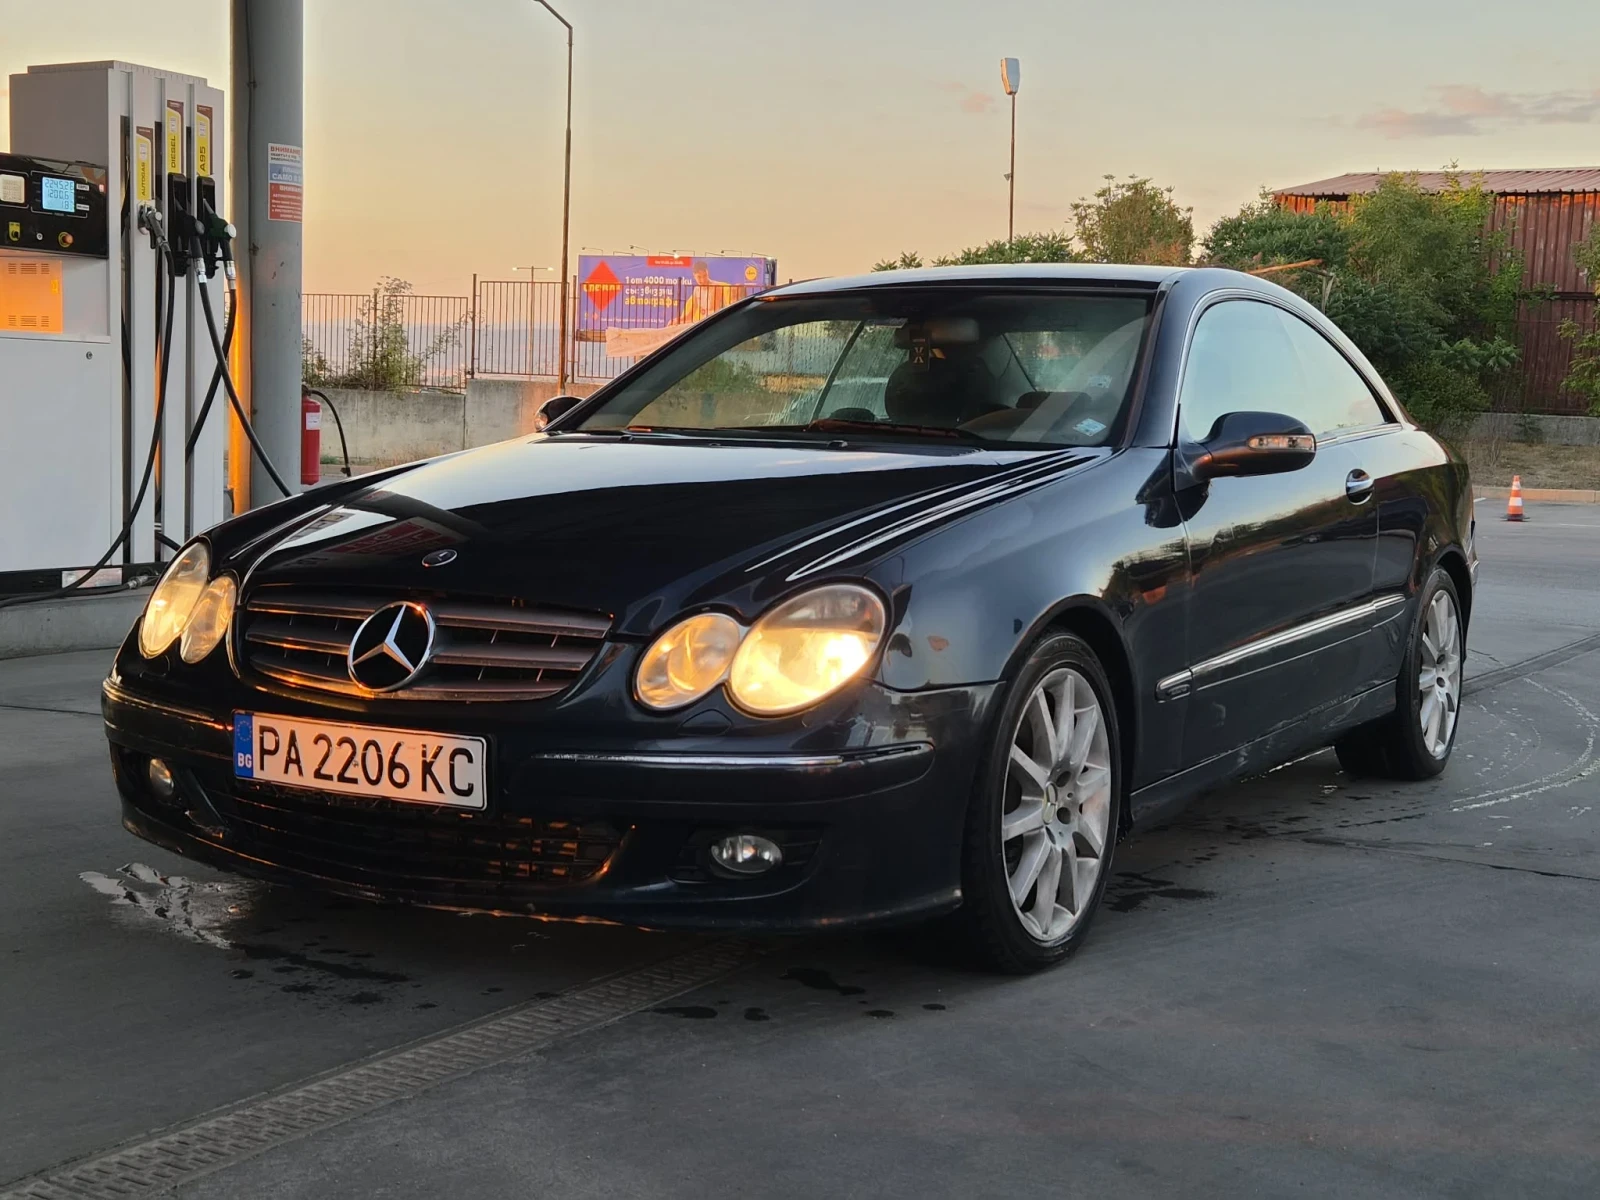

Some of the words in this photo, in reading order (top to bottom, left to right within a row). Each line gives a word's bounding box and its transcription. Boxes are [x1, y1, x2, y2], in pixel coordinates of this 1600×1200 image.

[644, 276, 664, 285] 4000
[665, 276, 693, 285] токи
[237, 752, 252, 769] BG
[258, 724, 304, 777] PA
[312, 733, 410, 789] 2206
[421, 743, 474, 797] KC
